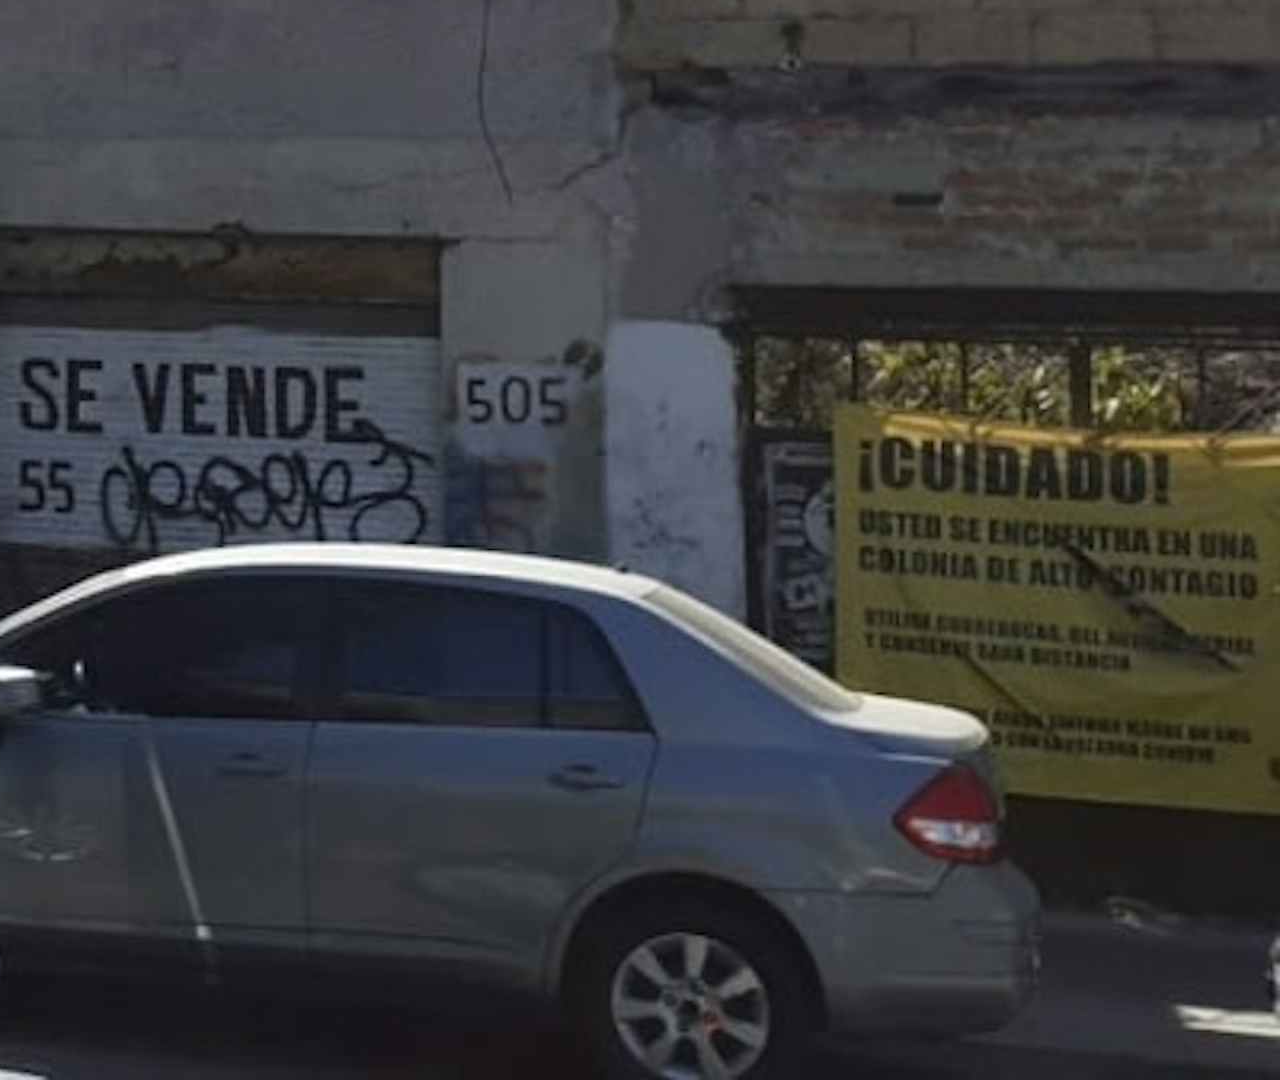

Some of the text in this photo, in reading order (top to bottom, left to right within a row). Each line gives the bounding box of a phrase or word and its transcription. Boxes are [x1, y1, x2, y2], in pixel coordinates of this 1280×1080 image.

[20, 358, 104, 435] SE
[132, 361, 367, 444] VENDE
[467, 376, 569, 425] 505
[19, 459, 76, 514] 55
[859, 436, 1171, 505] ¡CUIDADO!
[859, 508, 1259, 562] USTED SE ENCUENTRA EN UNA
[859, 546, 1258, 601] COLONIA DE ALTO CONTAGIO
